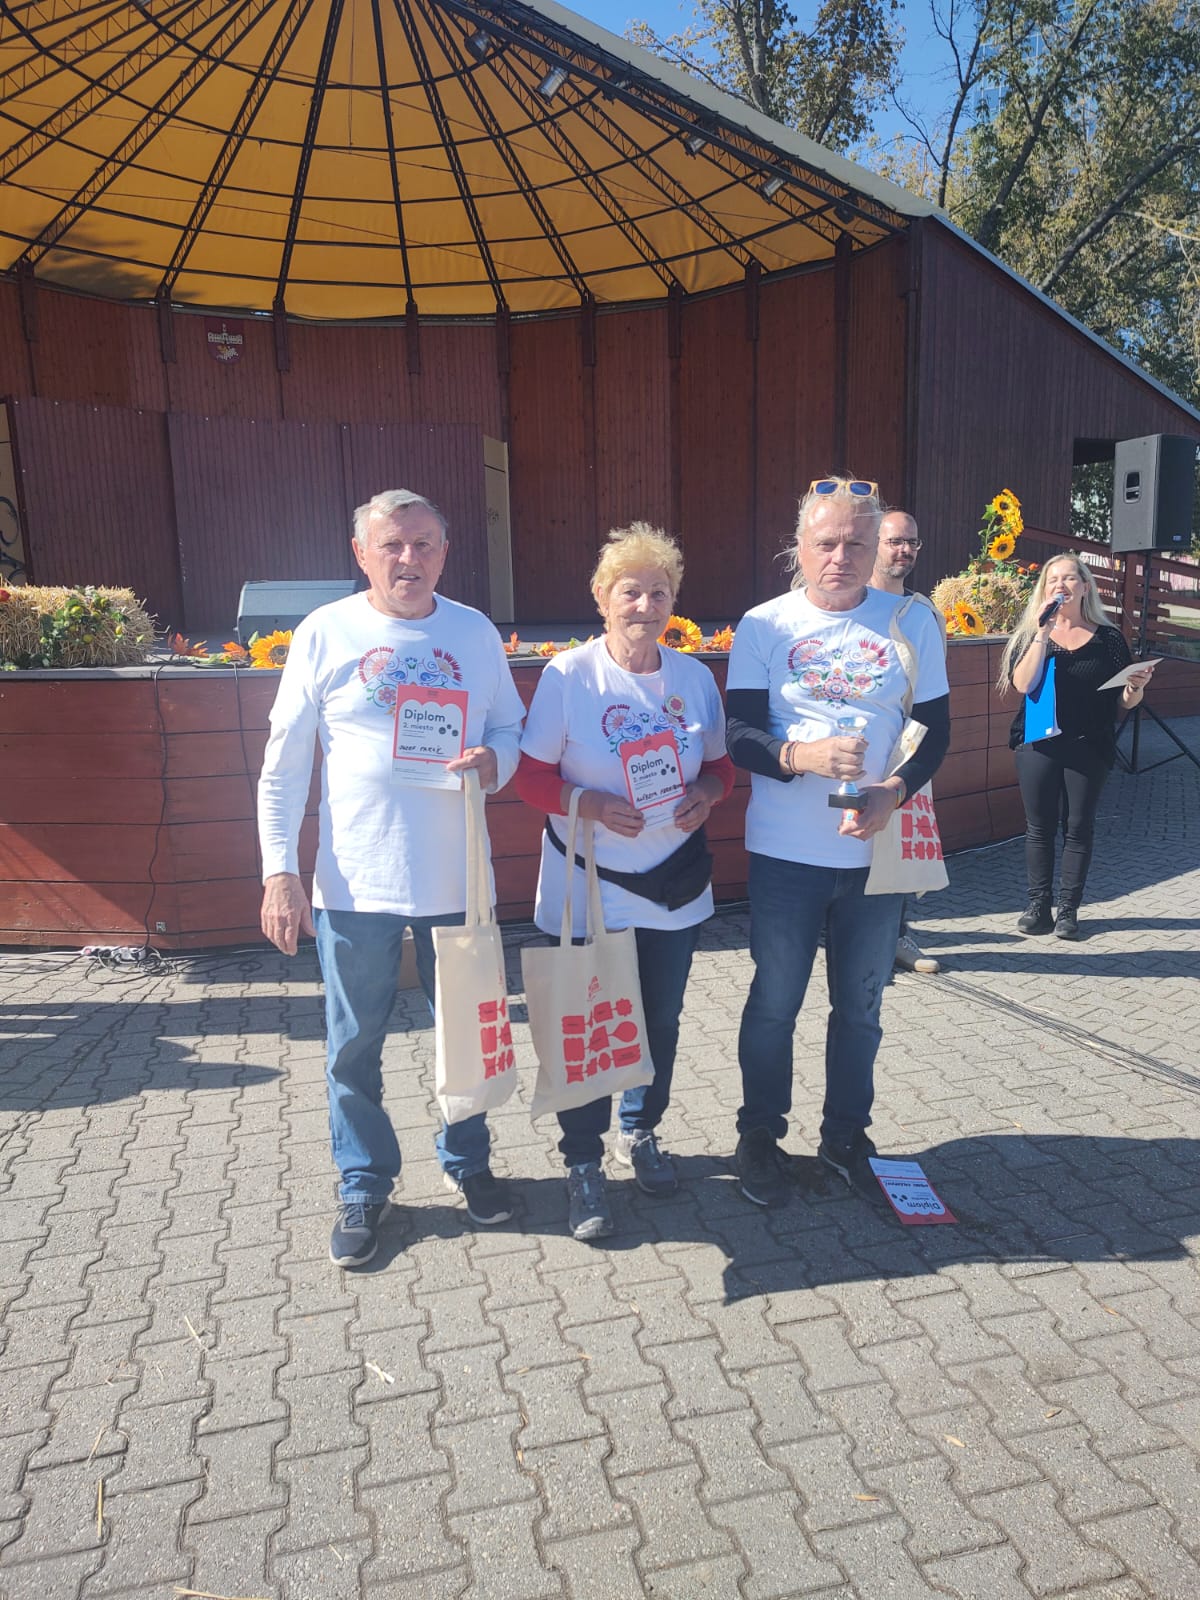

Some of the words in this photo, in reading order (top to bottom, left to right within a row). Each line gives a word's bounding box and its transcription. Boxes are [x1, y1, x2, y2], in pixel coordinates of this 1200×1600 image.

[404, 709, 445, 722] Diplom
[410, 723, 434, 731] miesto
[631, 758, 663, 774] Diplom
[907, 1201, 941, 1210] Diplom
